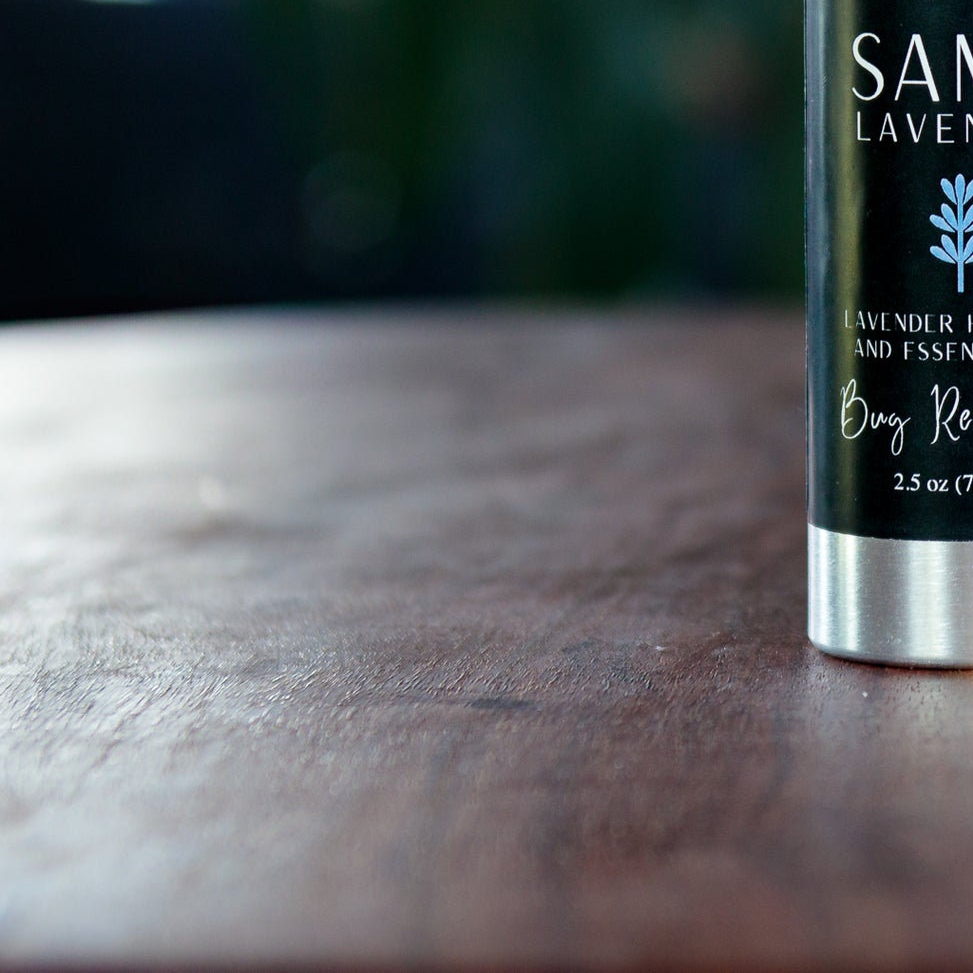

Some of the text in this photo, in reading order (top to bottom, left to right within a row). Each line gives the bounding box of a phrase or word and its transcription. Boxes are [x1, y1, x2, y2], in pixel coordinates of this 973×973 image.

[844, 309, 954, 333] LAVENDER
[854, 338, 892, 359] AND
[840, 378, 911, 456] Bug
[893, 473, 921, 492] 2.5
[926, 479, 949, 492] oz
